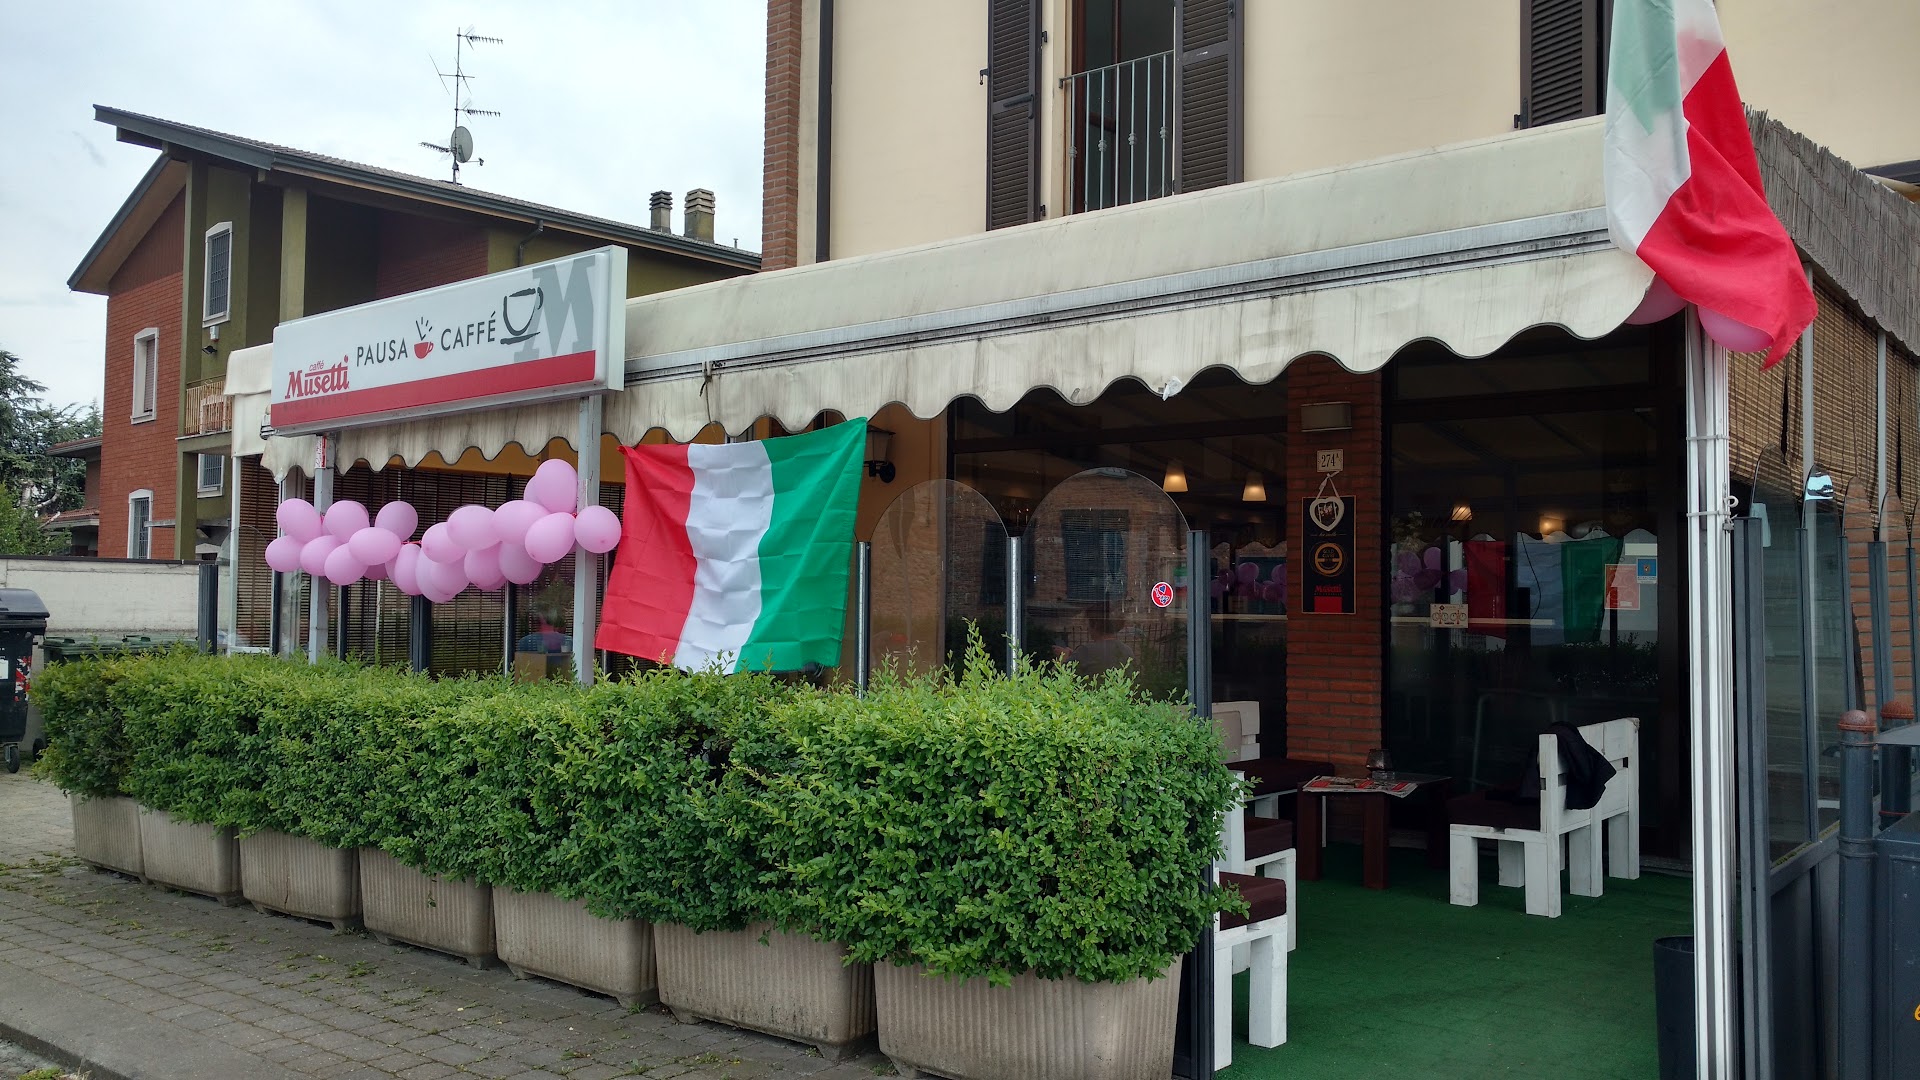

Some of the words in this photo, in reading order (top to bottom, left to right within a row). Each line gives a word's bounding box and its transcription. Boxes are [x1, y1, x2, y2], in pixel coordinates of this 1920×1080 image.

[356, 339, 408, 367] PAUSA
[440, 311, 497, 351] CAFFÉ
[284, 354, 350, 399] Musetti
